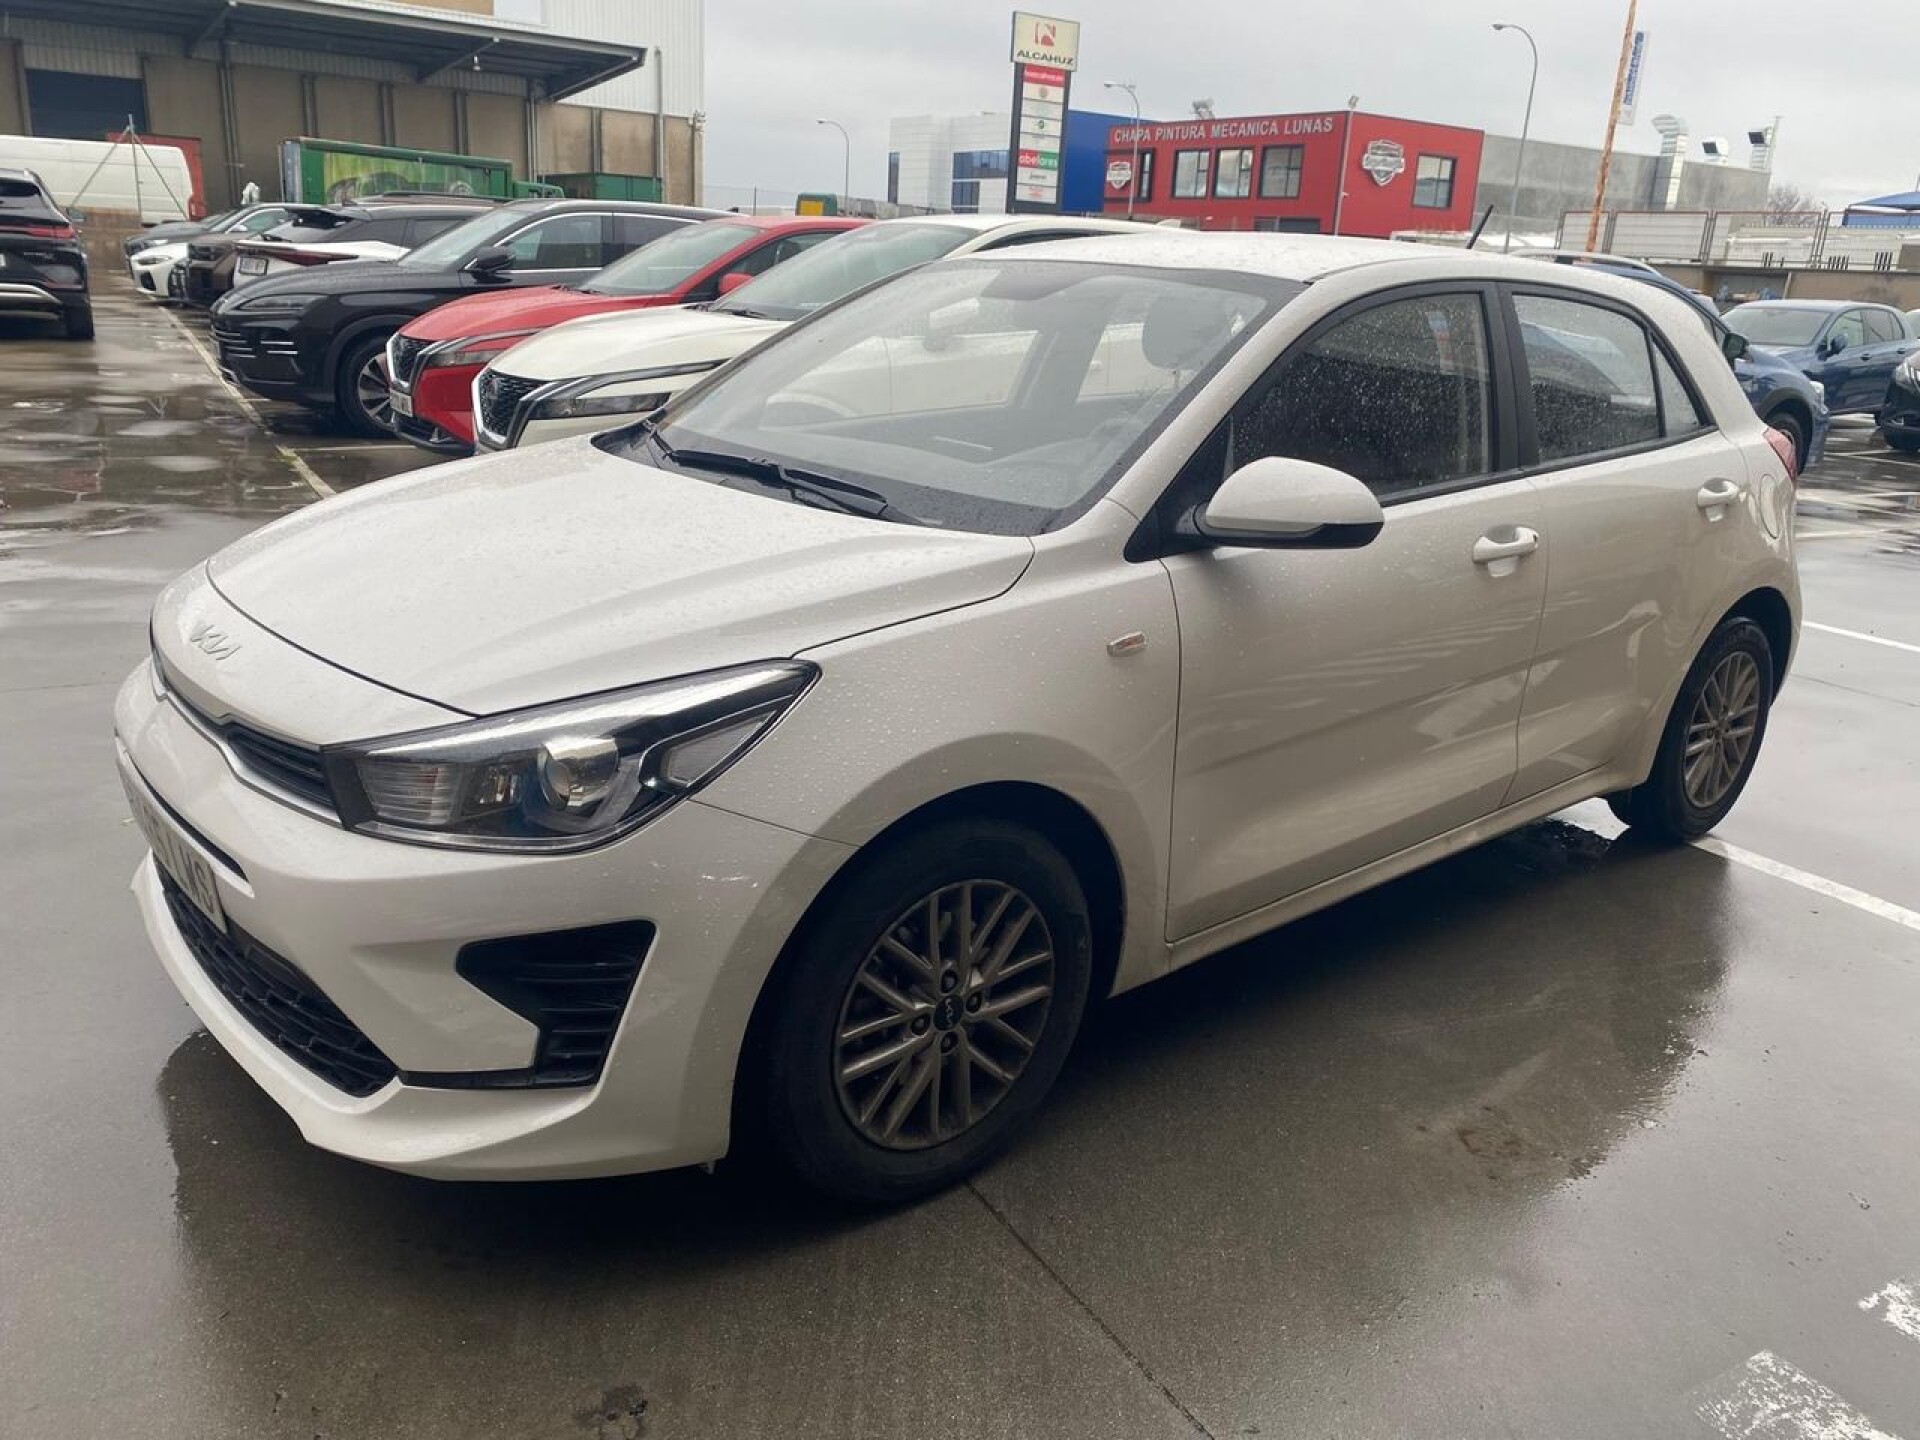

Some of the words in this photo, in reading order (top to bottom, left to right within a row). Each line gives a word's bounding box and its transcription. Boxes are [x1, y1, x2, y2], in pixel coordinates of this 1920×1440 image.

[1016, 49, 1075, 66] ALCAHUZ
[1114, 127, 1151, 142] CHAPA
[1154, 124, 1206, 141] PINTURA
[1211, 119, 1279, 139] MECANICA
[1284, 116, 1333, 135] LUNAS
